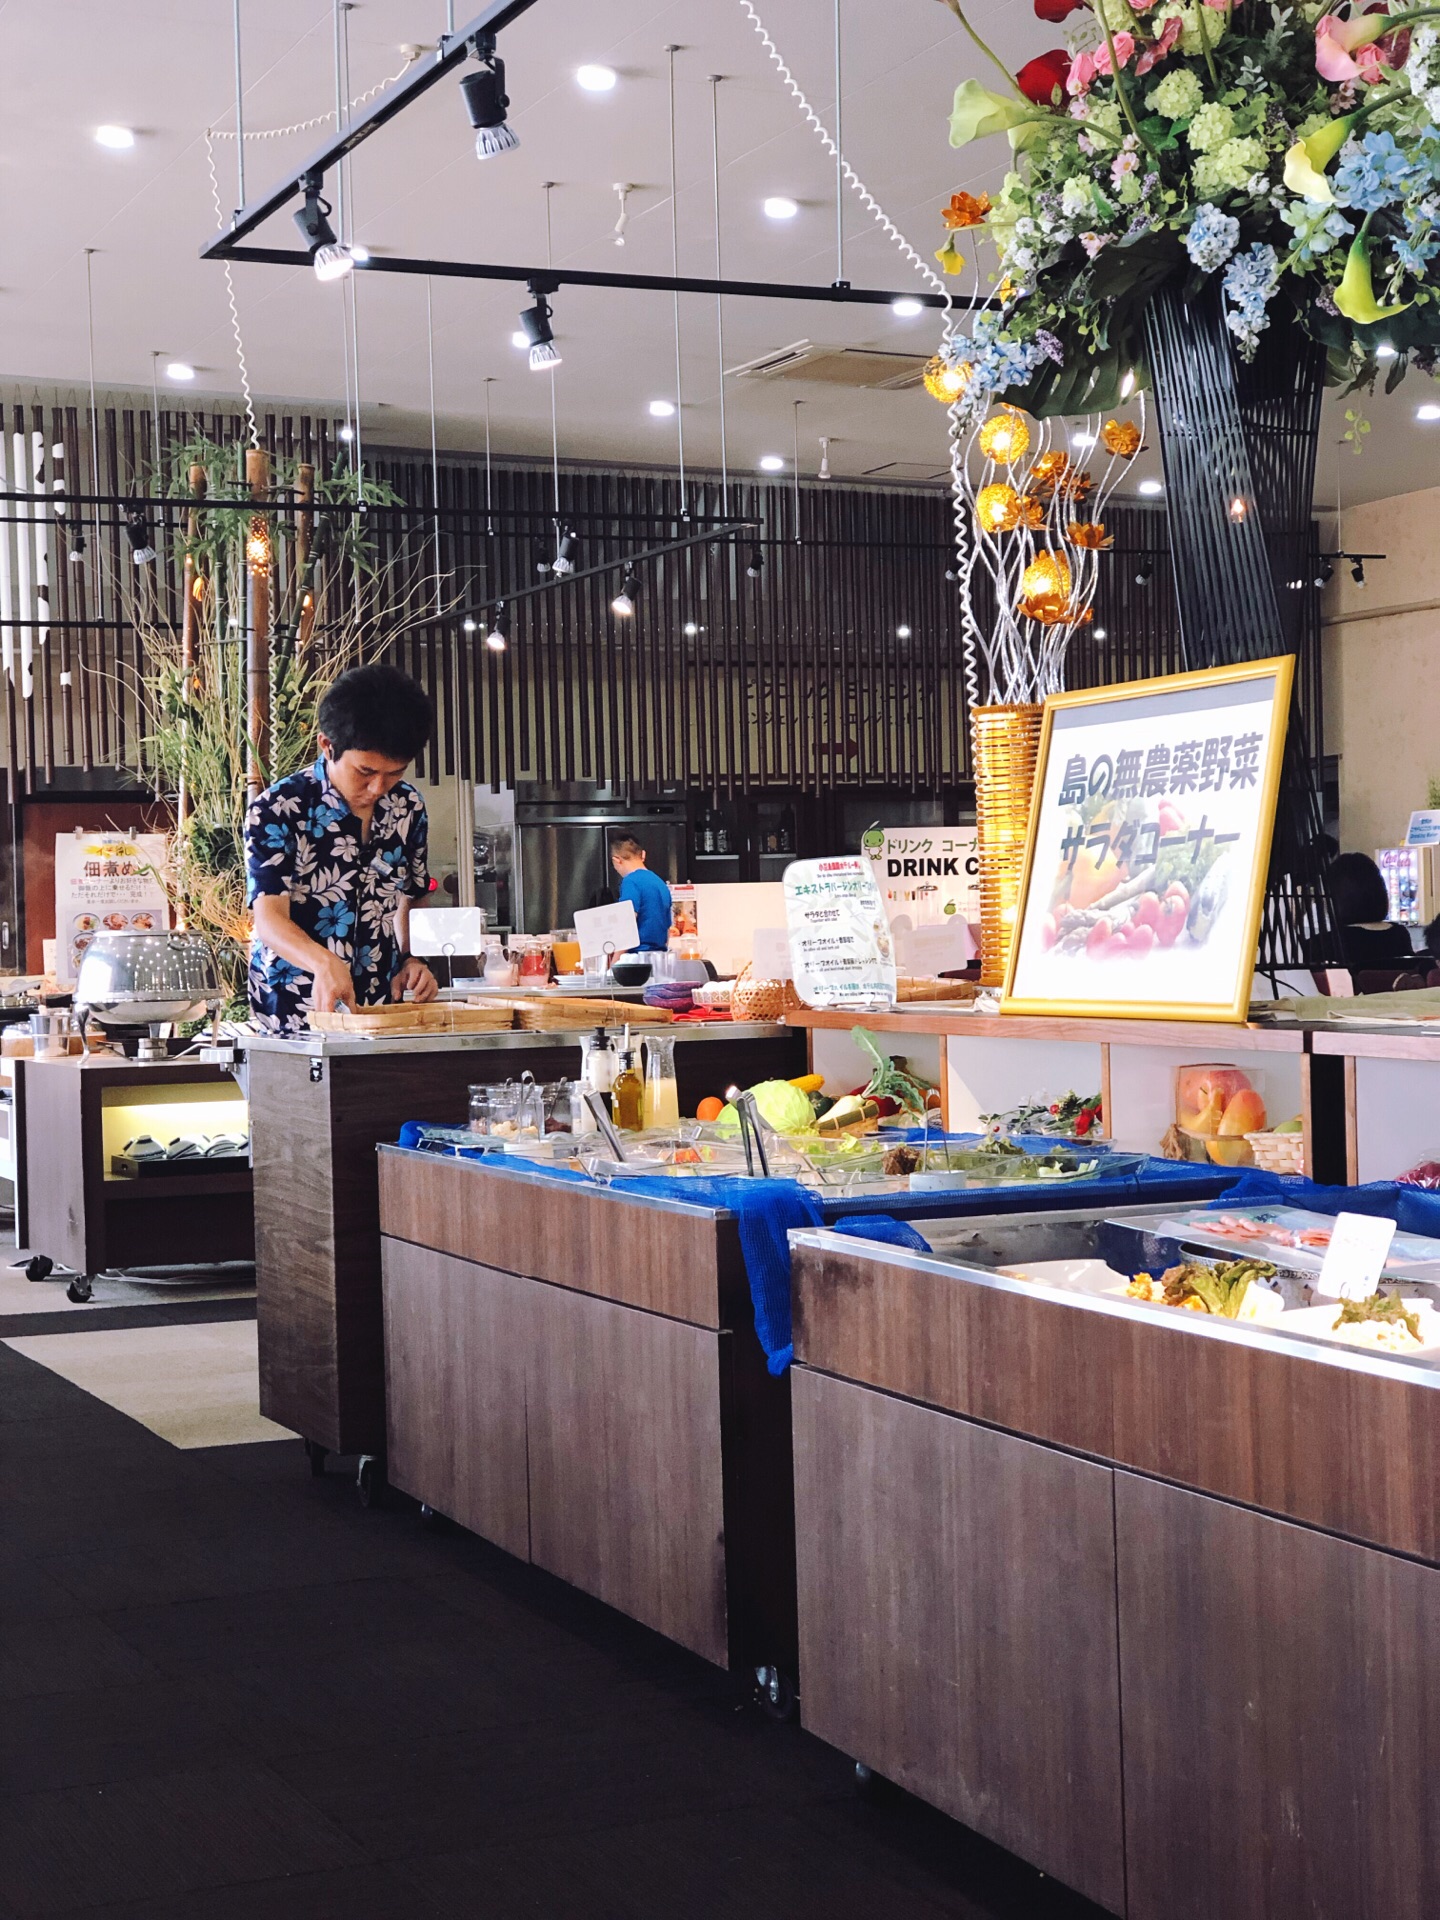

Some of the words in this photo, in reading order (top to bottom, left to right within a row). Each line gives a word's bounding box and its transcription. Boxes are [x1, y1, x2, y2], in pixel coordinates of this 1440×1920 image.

[1058, 731, 1263, 806] 島の無農薬野菜
[887, 838, 933, 854] ドリンク
[942, 837, 977, 852] コーナ
[1060, 814, 1240, 870] サラダコーナー
[887, 857, 959, 877] DRINK
[965, 857, 979, 875] C
